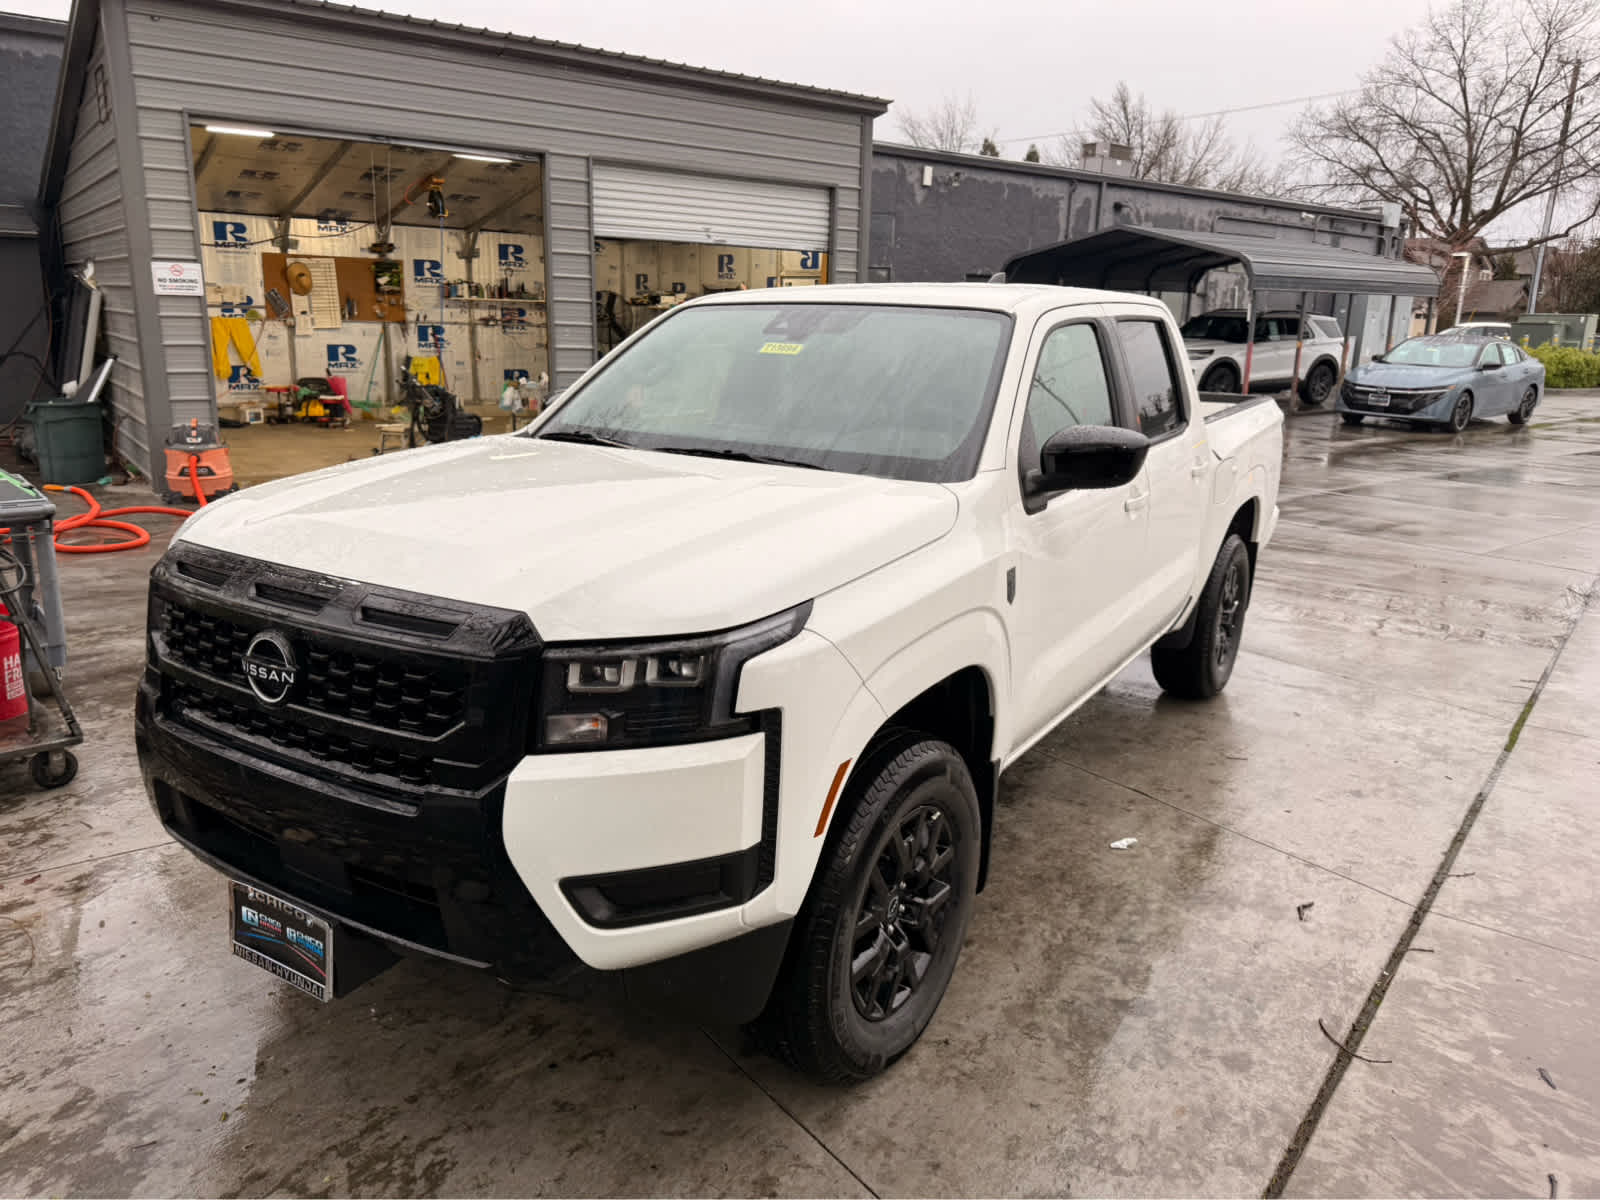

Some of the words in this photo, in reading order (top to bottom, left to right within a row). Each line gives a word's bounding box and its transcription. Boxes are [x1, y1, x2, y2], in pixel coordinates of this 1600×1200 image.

[213, 221, 248, 242] R
[498, 244, 525, 262] R
[413, 259, 443, 277] R
[718, 254, 735, 272] R
[417, 325, 445, 342] R
[327, 344, 357, 361] R
[242, 660, 294, 683] NISSAN
